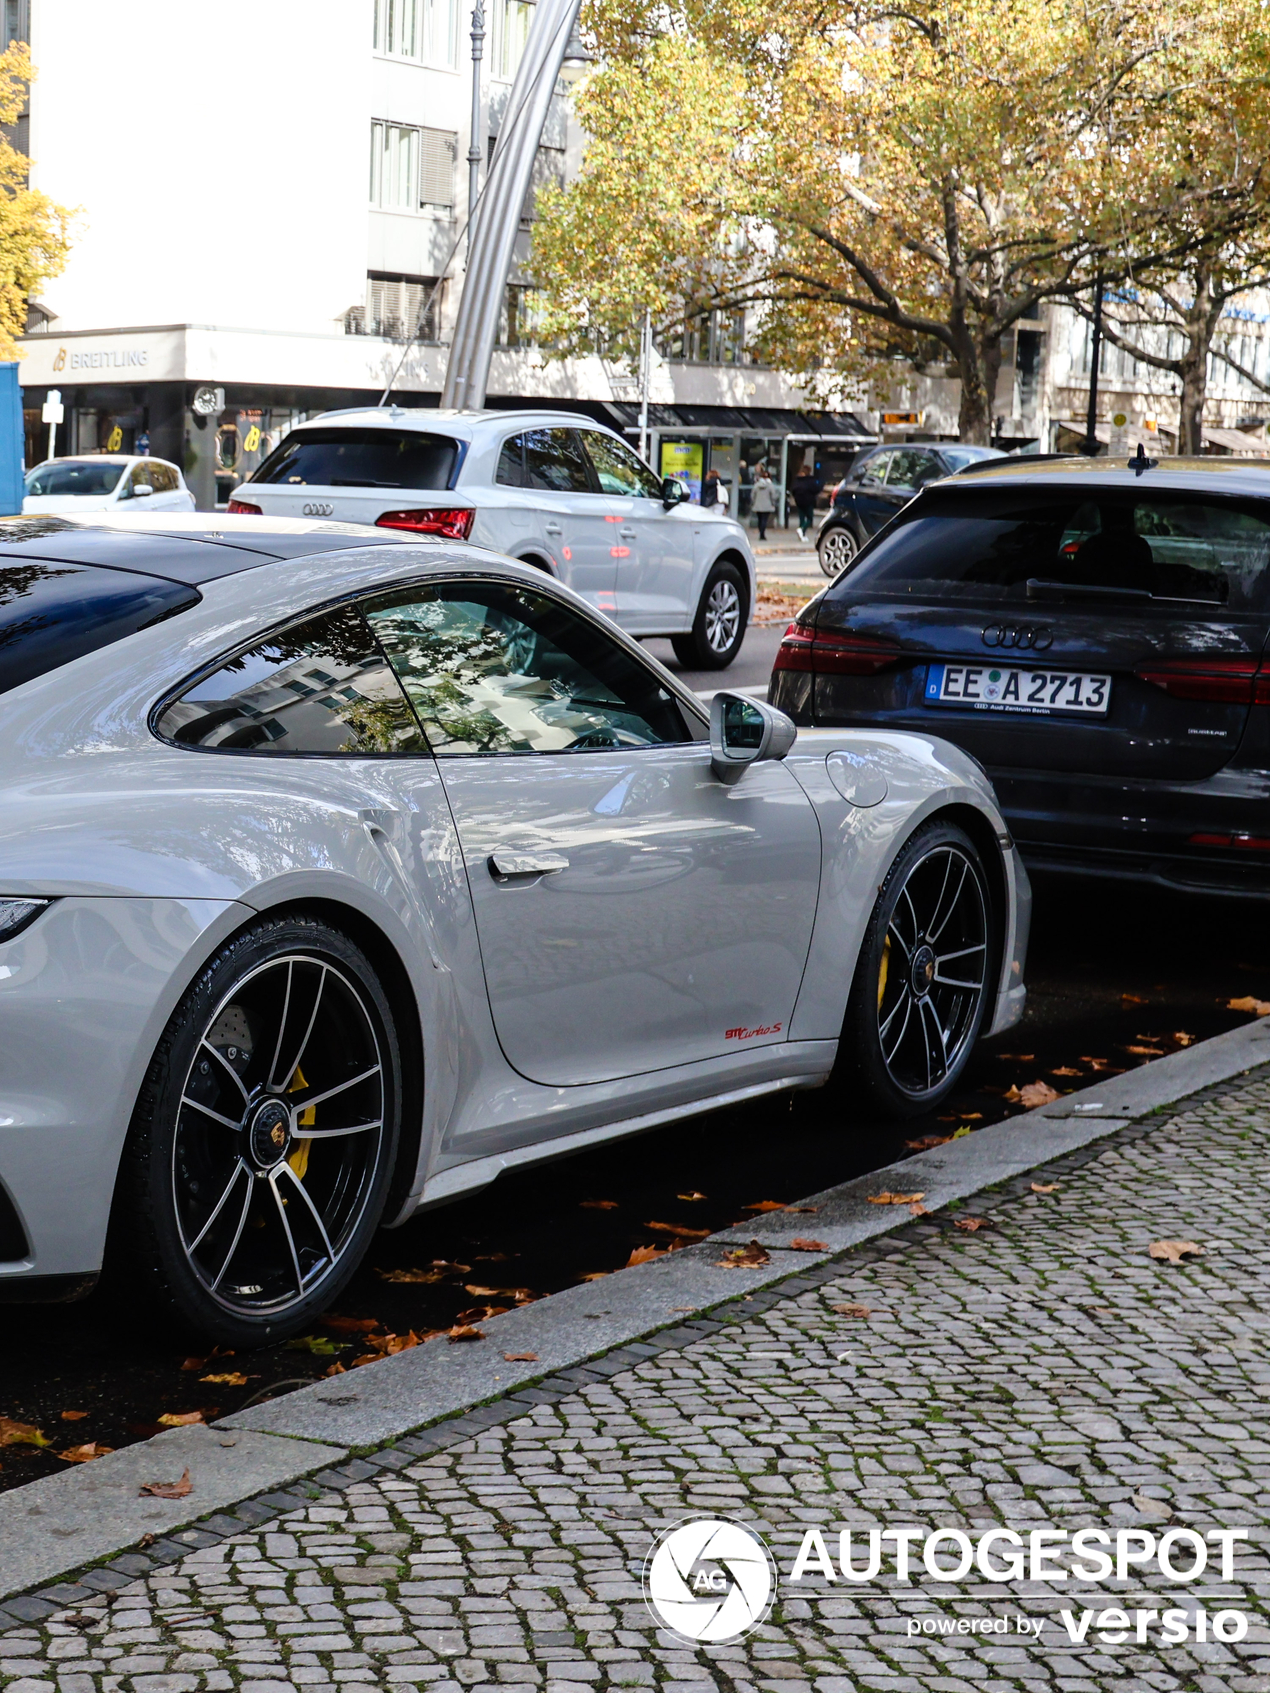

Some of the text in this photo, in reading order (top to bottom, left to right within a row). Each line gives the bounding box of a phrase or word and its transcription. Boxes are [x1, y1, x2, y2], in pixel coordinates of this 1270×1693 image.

[70, 350, 148, 370] BREITLING
[930, 684, 937, 694] D
[943, 667, 1107, 707] EE A 2713
[1005, 705, 1031, 713] Zentrum
